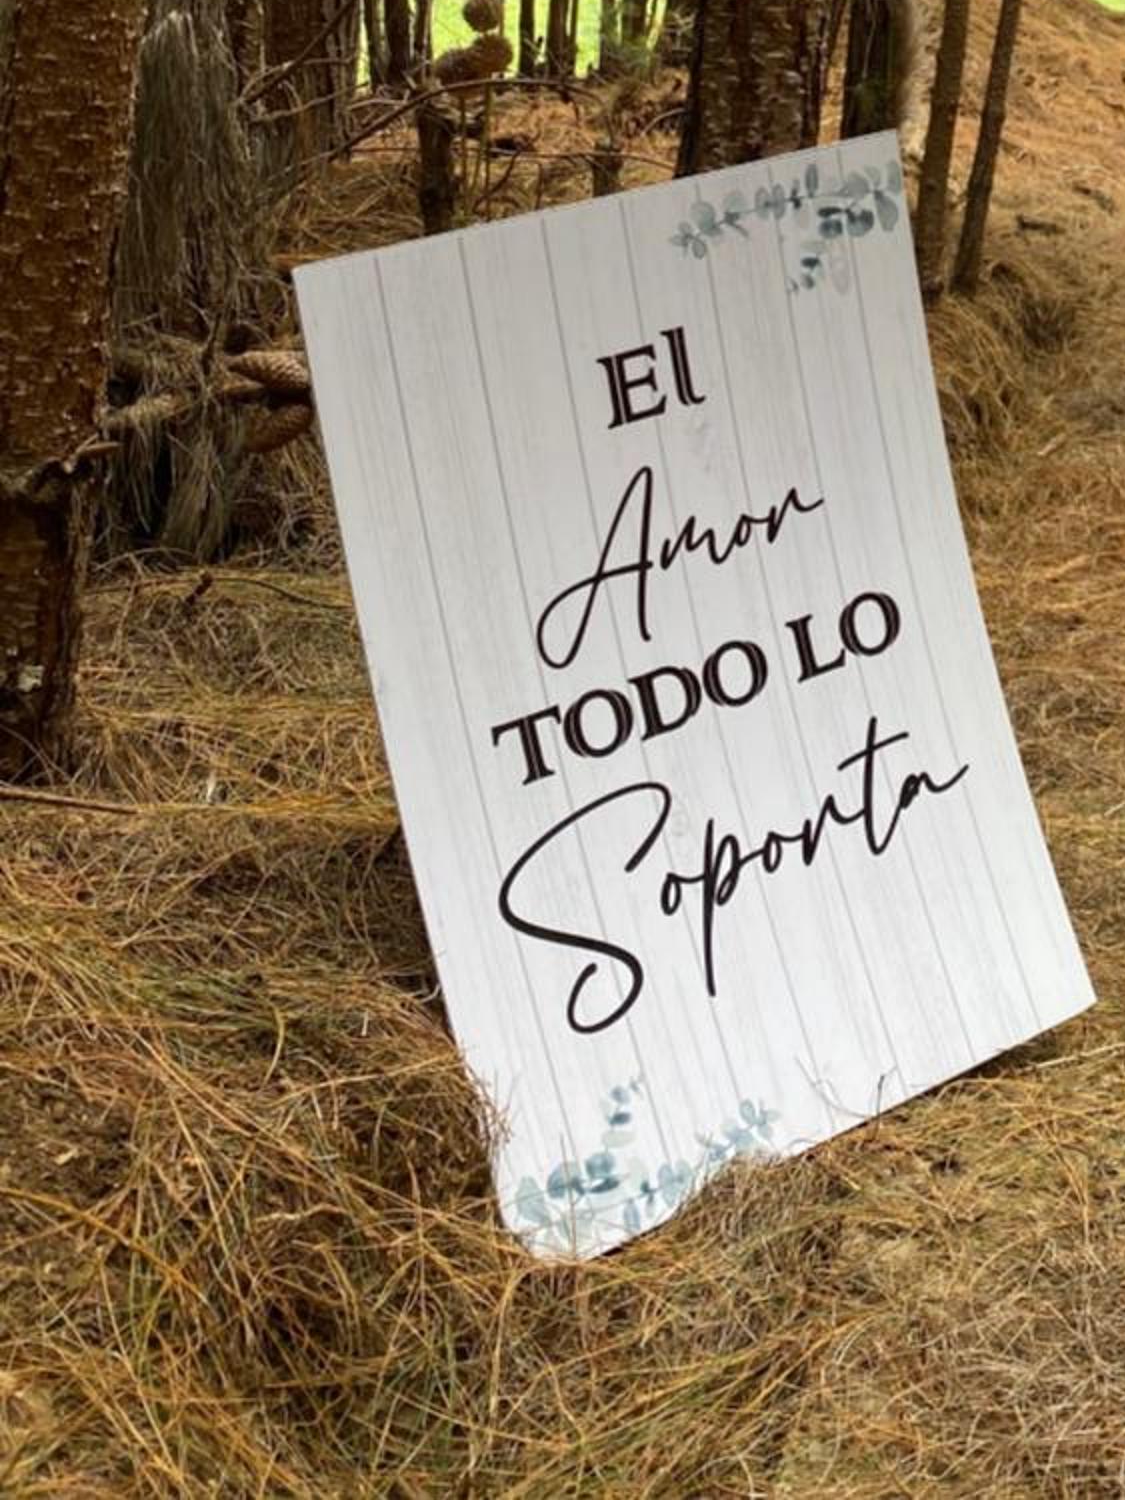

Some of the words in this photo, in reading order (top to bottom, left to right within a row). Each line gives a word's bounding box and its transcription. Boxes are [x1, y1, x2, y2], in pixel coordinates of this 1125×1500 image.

[596, 326, 706, 429] El
[535, 465, 825, 670] Amor
[491, 638, 768, 787] TODO
[785, 591, 902, 682] LO
[497, 716, 970, 1036] Soporta
